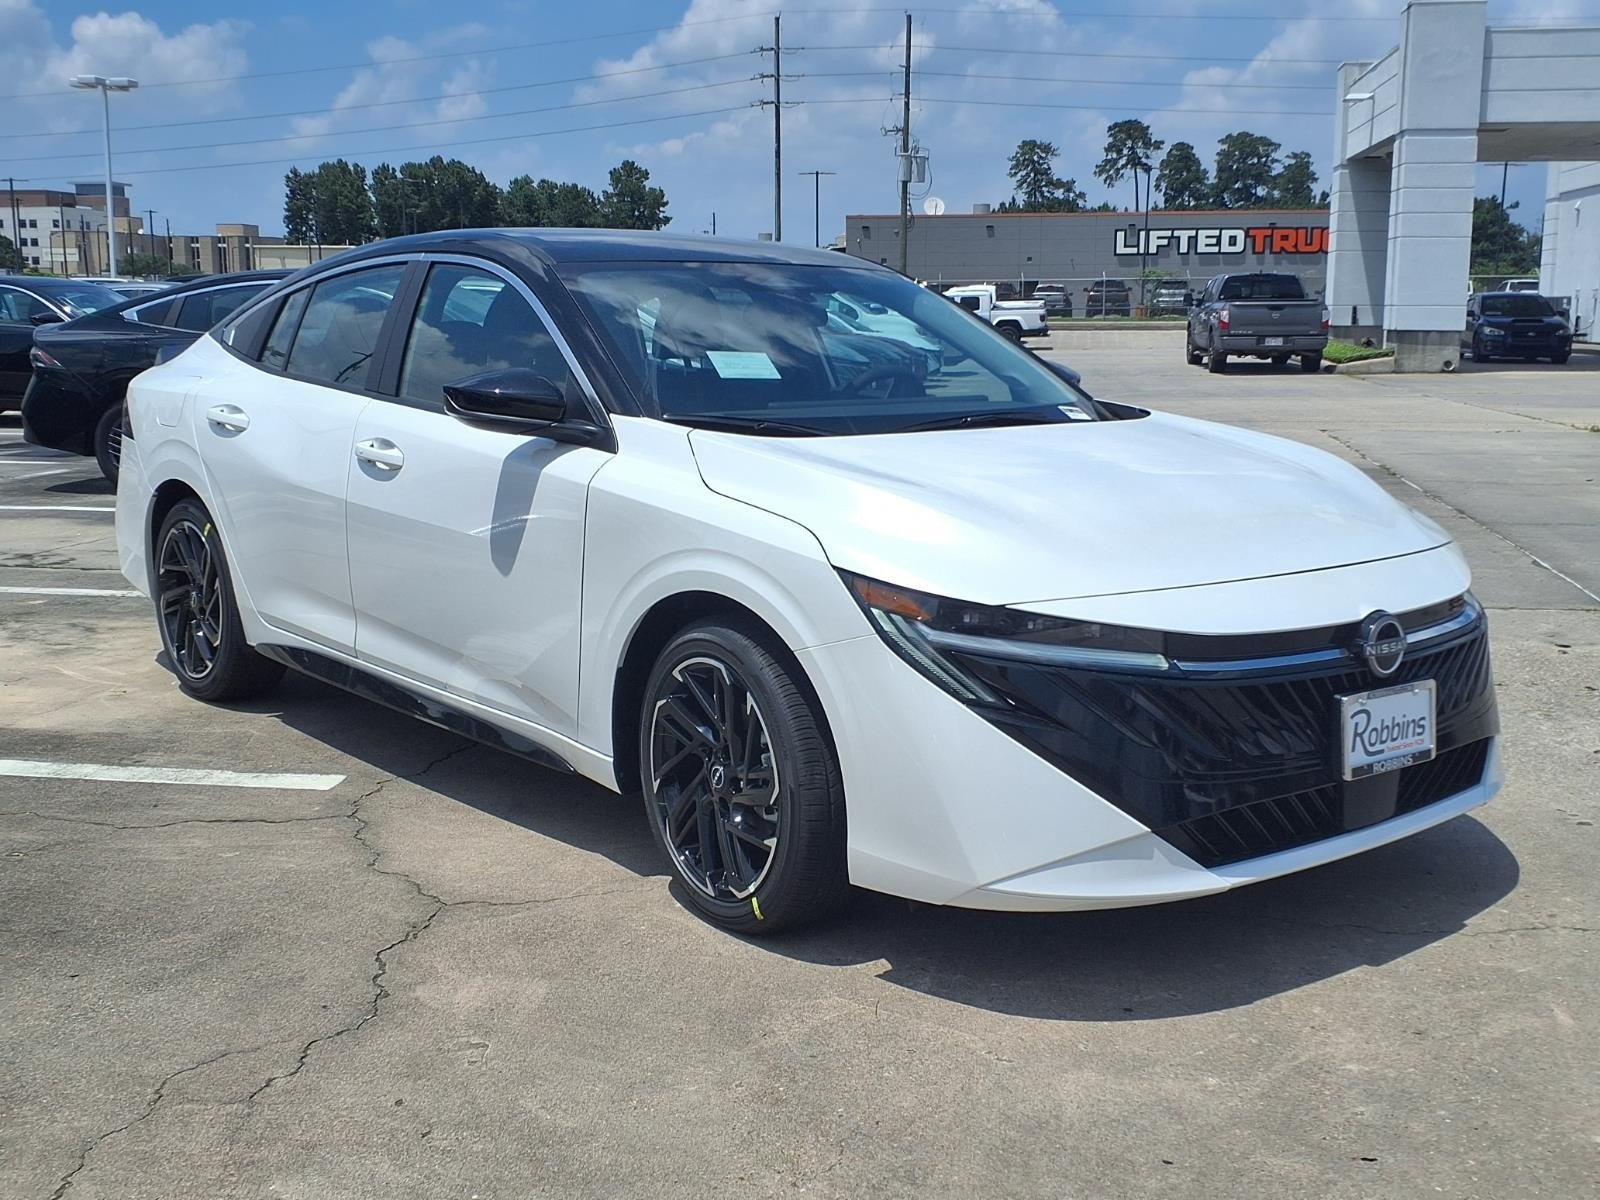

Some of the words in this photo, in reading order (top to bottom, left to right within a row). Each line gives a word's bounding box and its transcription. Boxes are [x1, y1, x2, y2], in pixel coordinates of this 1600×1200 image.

[1115, 229, 1246, 254] LIFTED
[1350, 708, 1426, 757] Robbins
[1373, 754, 1414, 774] ROBBINS
